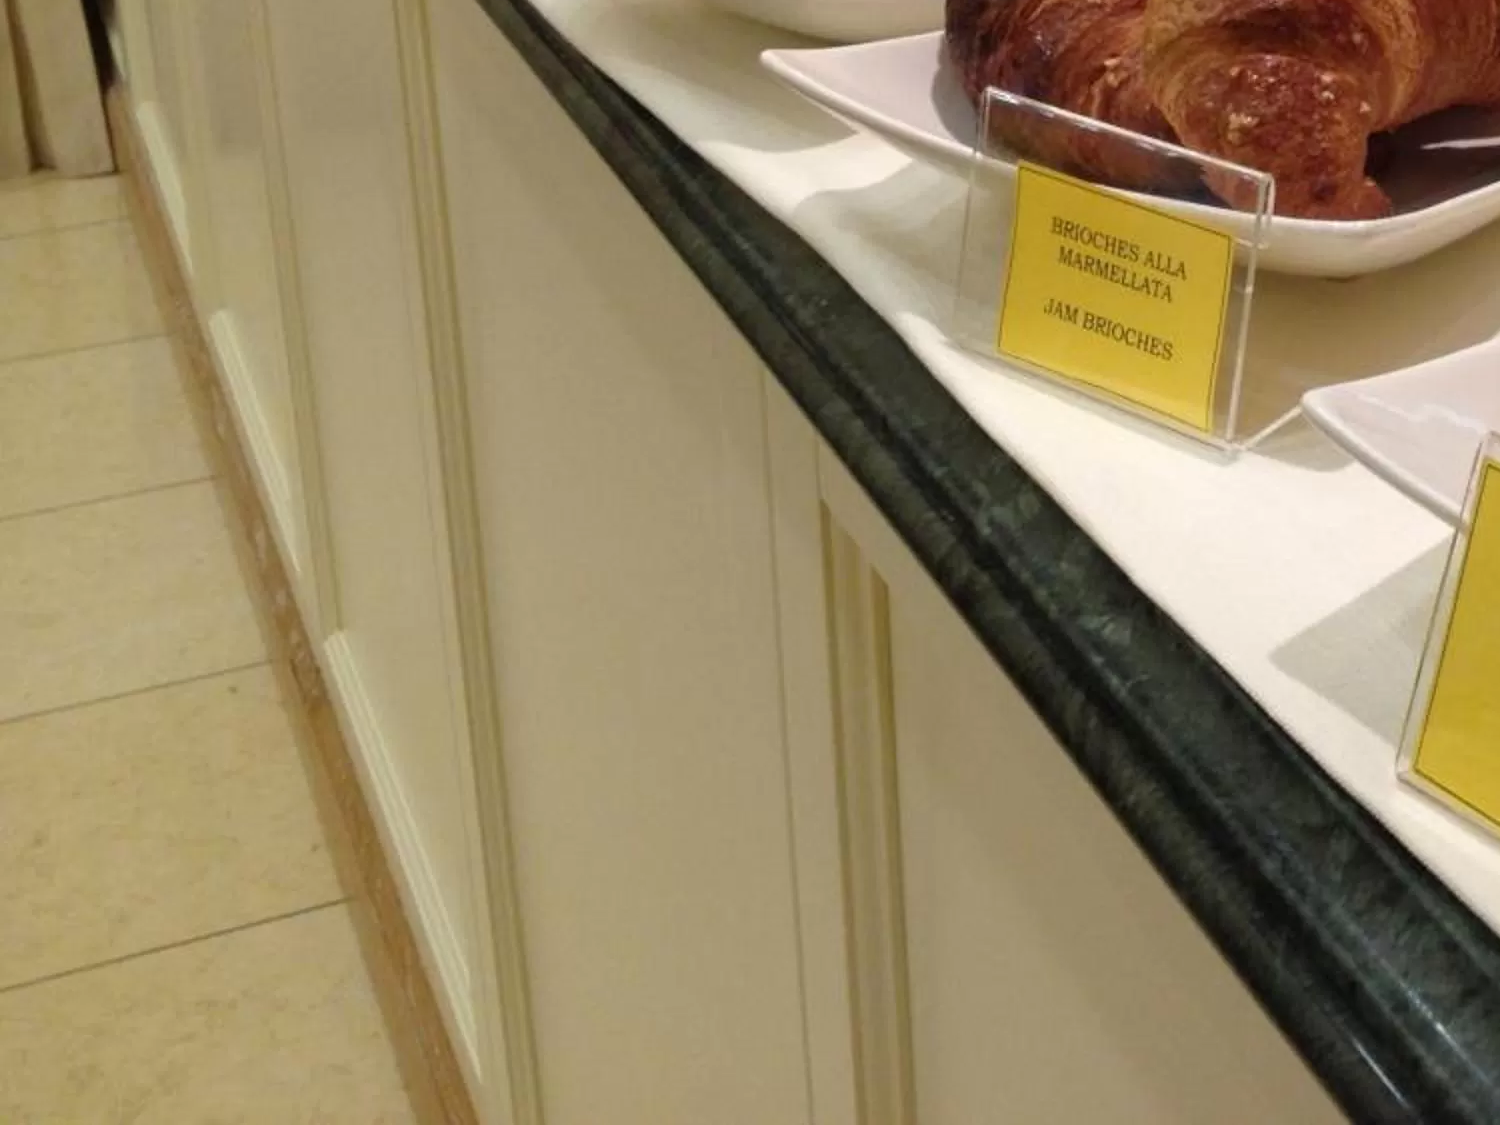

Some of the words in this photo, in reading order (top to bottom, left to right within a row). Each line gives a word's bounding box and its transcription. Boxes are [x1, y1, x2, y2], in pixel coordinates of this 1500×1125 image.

[1050, 216, 1139, 262] BRIOCHES
[1143, 250, 1188, 281] ALLA
[1058, 246, 1172, 303] MARMELLATA
[1043, 299, 1079, 325] JAM
[1083, 309, 1174, 361] BRIOCHES
